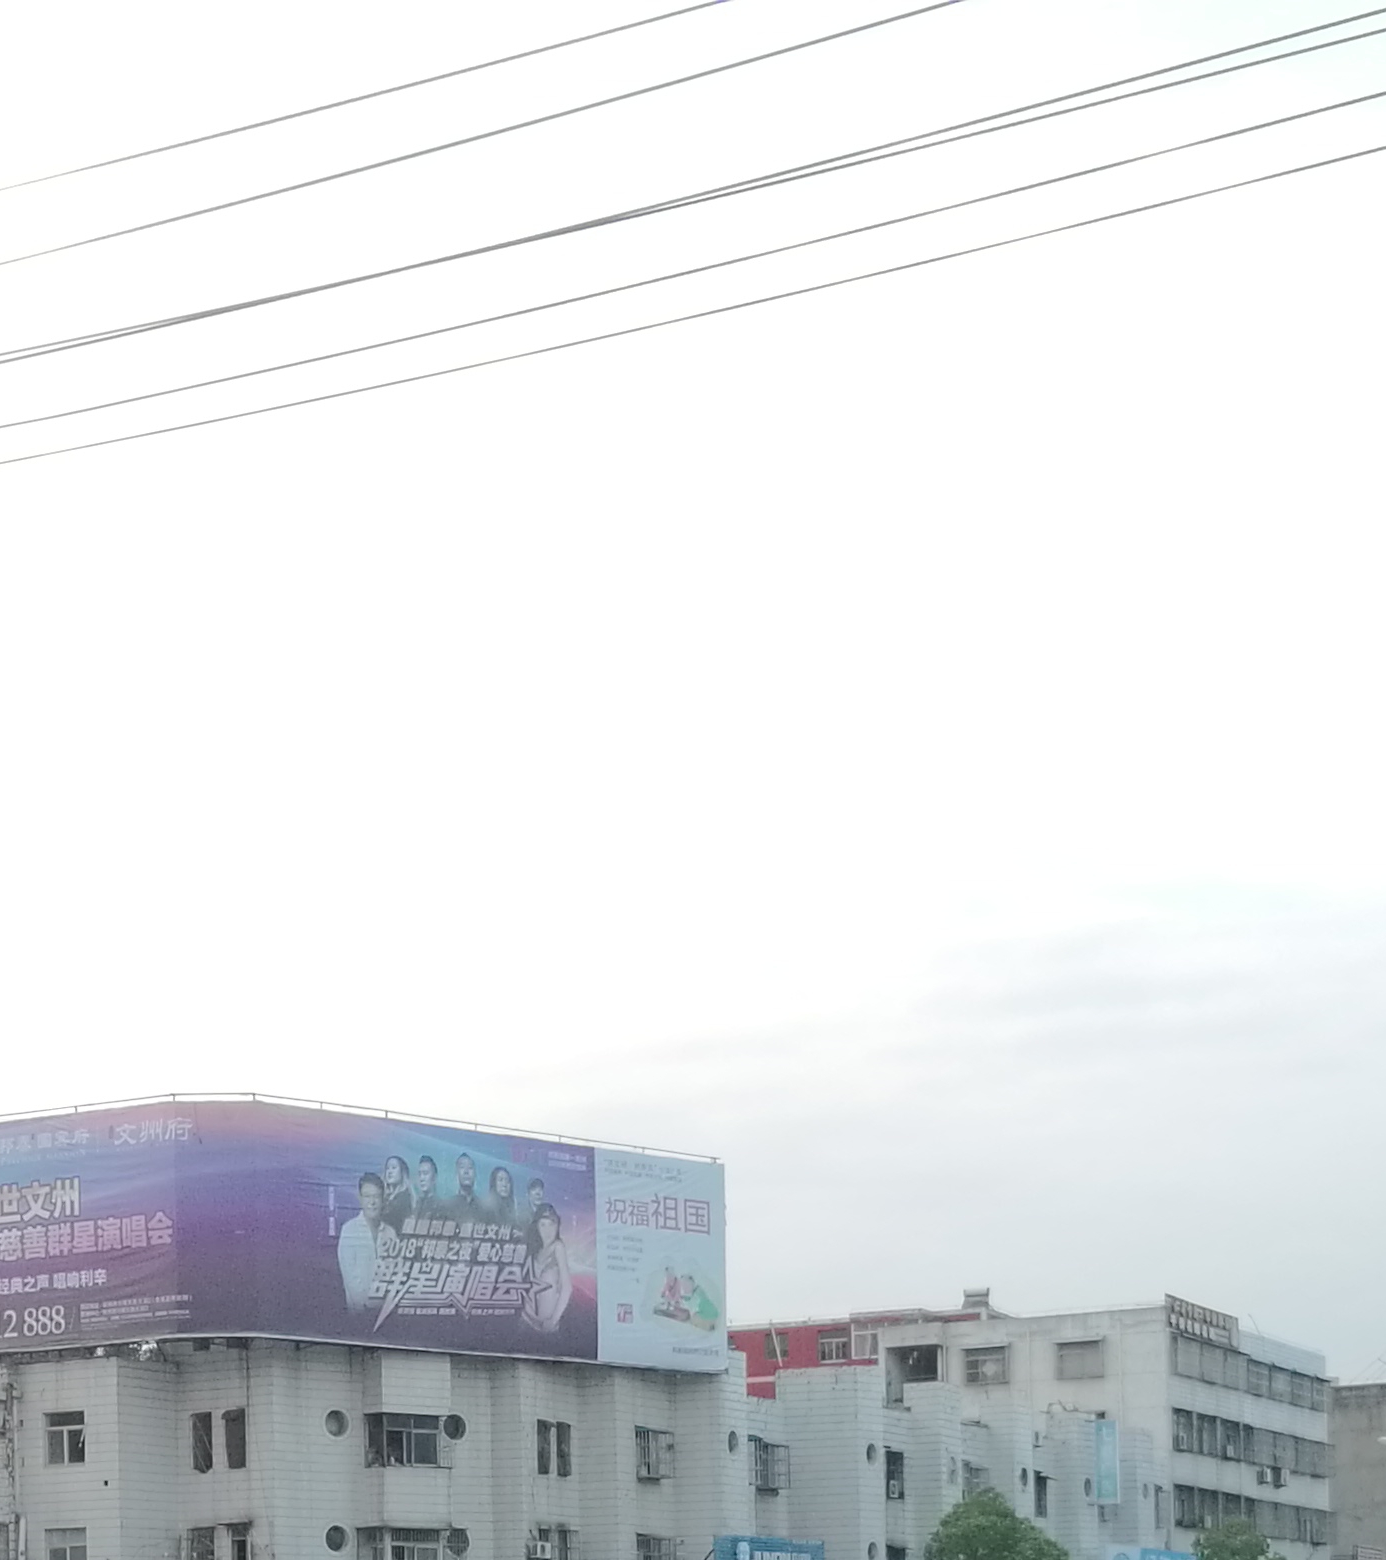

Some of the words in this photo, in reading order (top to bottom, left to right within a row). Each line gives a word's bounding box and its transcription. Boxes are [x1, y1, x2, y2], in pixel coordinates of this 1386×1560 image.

[114, 1117, 193, 1146] 文州府
[605, 1193, 711, 1236] 祝福祖国
[23, 1304, 66, 1337] 888
